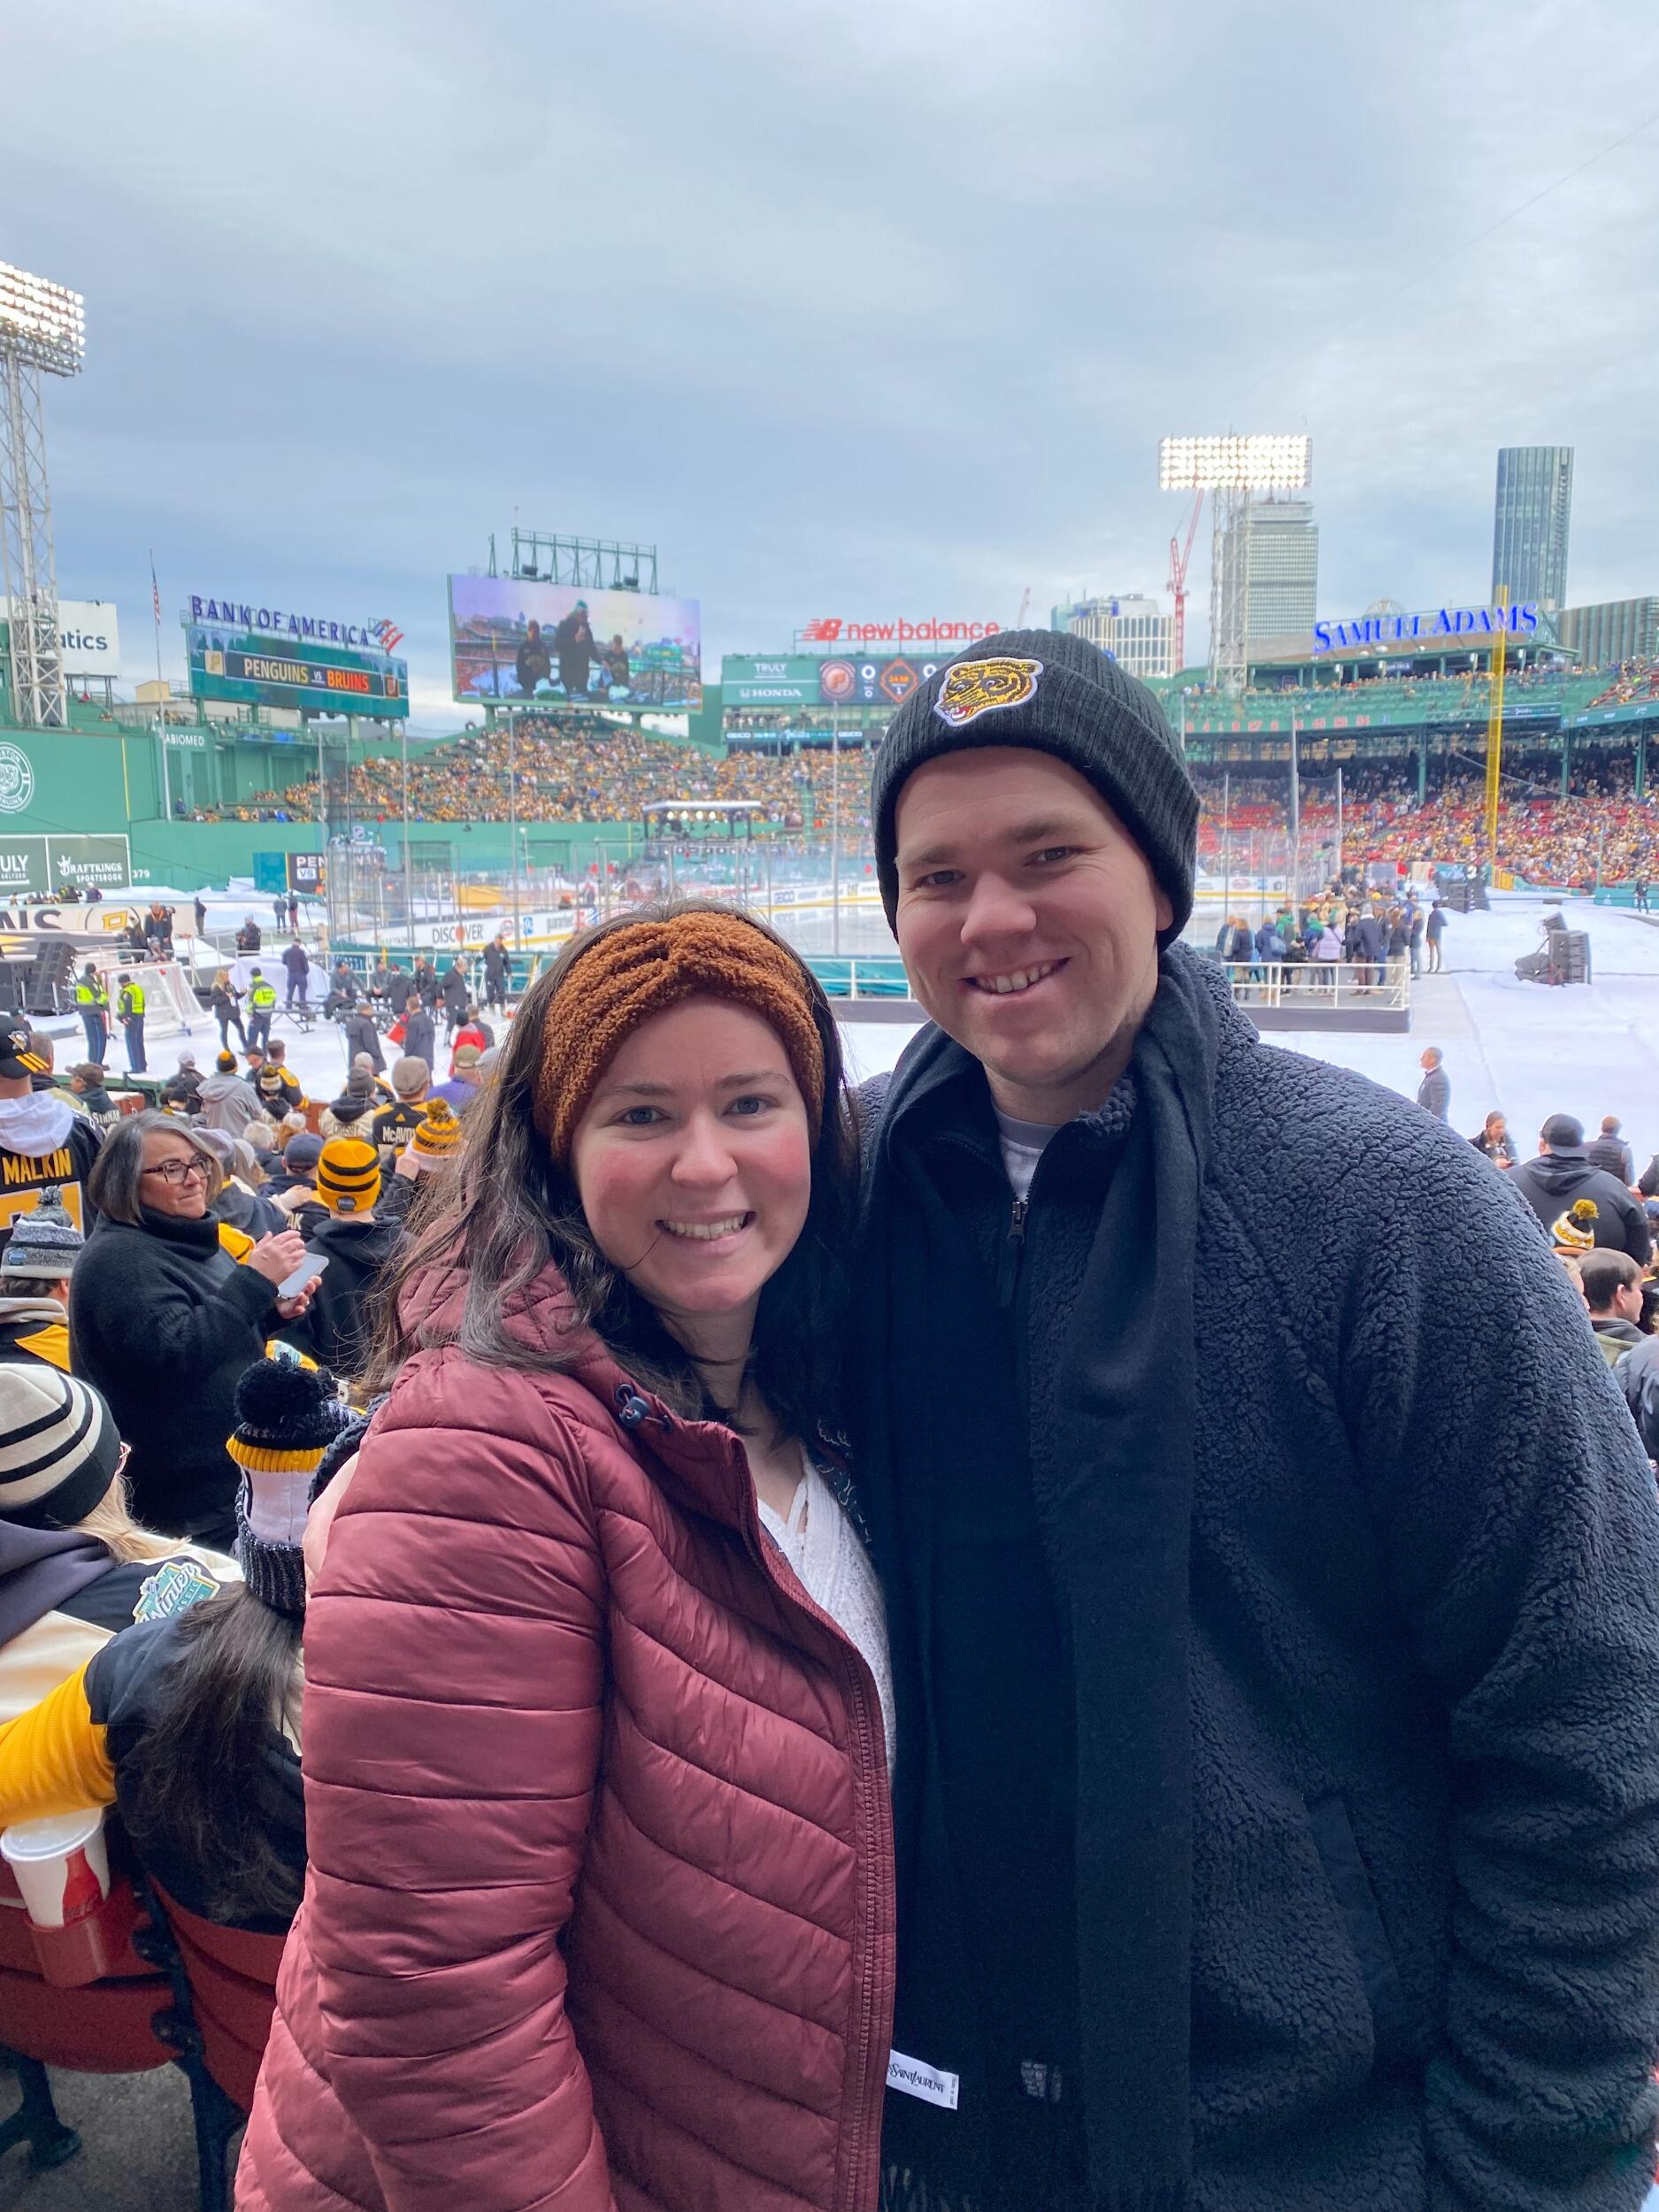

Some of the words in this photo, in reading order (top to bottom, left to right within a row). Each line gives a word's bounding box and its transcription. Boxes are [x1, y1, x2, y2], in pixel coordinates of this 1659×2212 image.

[191, 595, 250, 625] BANK
[257, 608, 281, 630] OF
[288, 613, 369, 646] AMERICA
[848, 622, 895, 641] new
[898, 618, 1000, 641] balance
[1314, 615, 1426, 653] SAMUEL
[1432, 603, 1538, 634] ADAMS
[243, 657, 308, 683] PENGUINS
[326, 670, 369, 692] BRUINS
[754, 663, 787, 672] TRULY
[752, 688, 803, 697] HONDA
[165, 733, 204, 747] ABIOMED
[59, 862, 123, 877] DRAFTKINGS
[75, 873, 123, 884] SPORTSBOOK
[432, 924, 484, 944] DISCOVER
[3, 1148, 72, 1186] MALKIN
